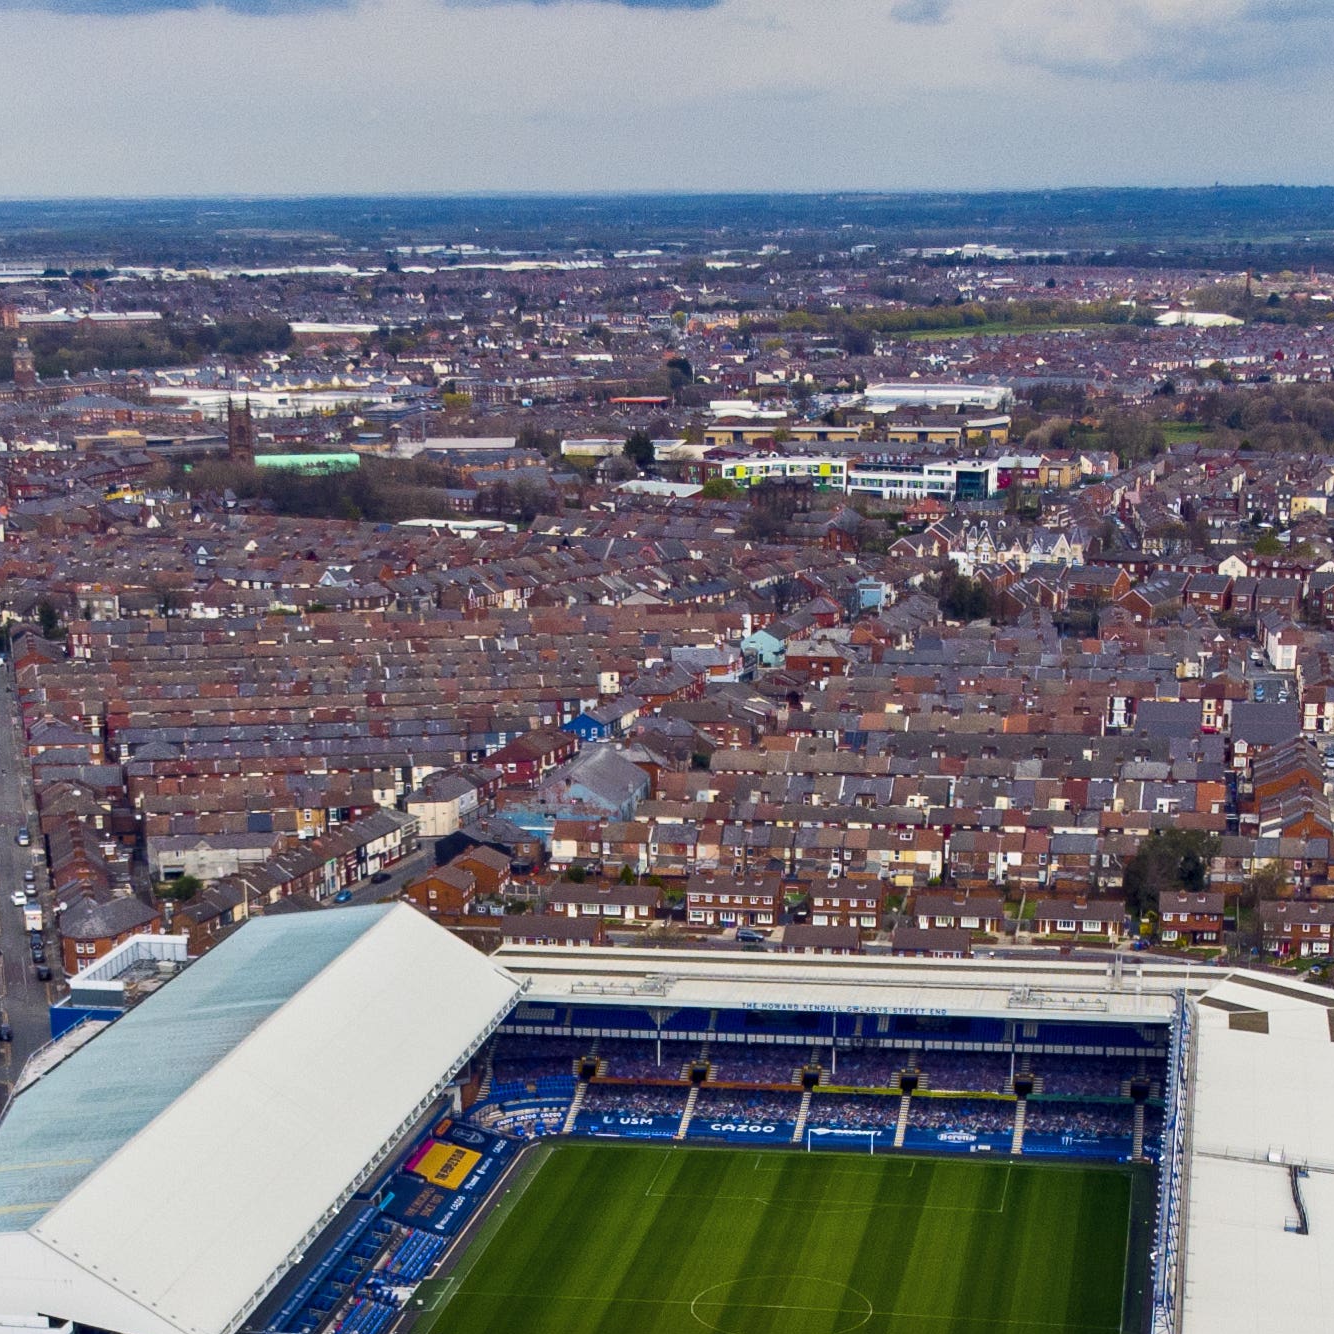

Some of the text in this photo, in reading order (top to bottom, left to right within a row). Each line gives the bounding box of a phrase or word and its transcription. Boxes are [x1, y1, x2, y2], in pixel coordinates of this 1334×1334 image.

[761, 1002, 799, 1010] HOWARD
[619, 1116, 654, 1126] USM
[710, 1122, 776, 1134] CAZOO
